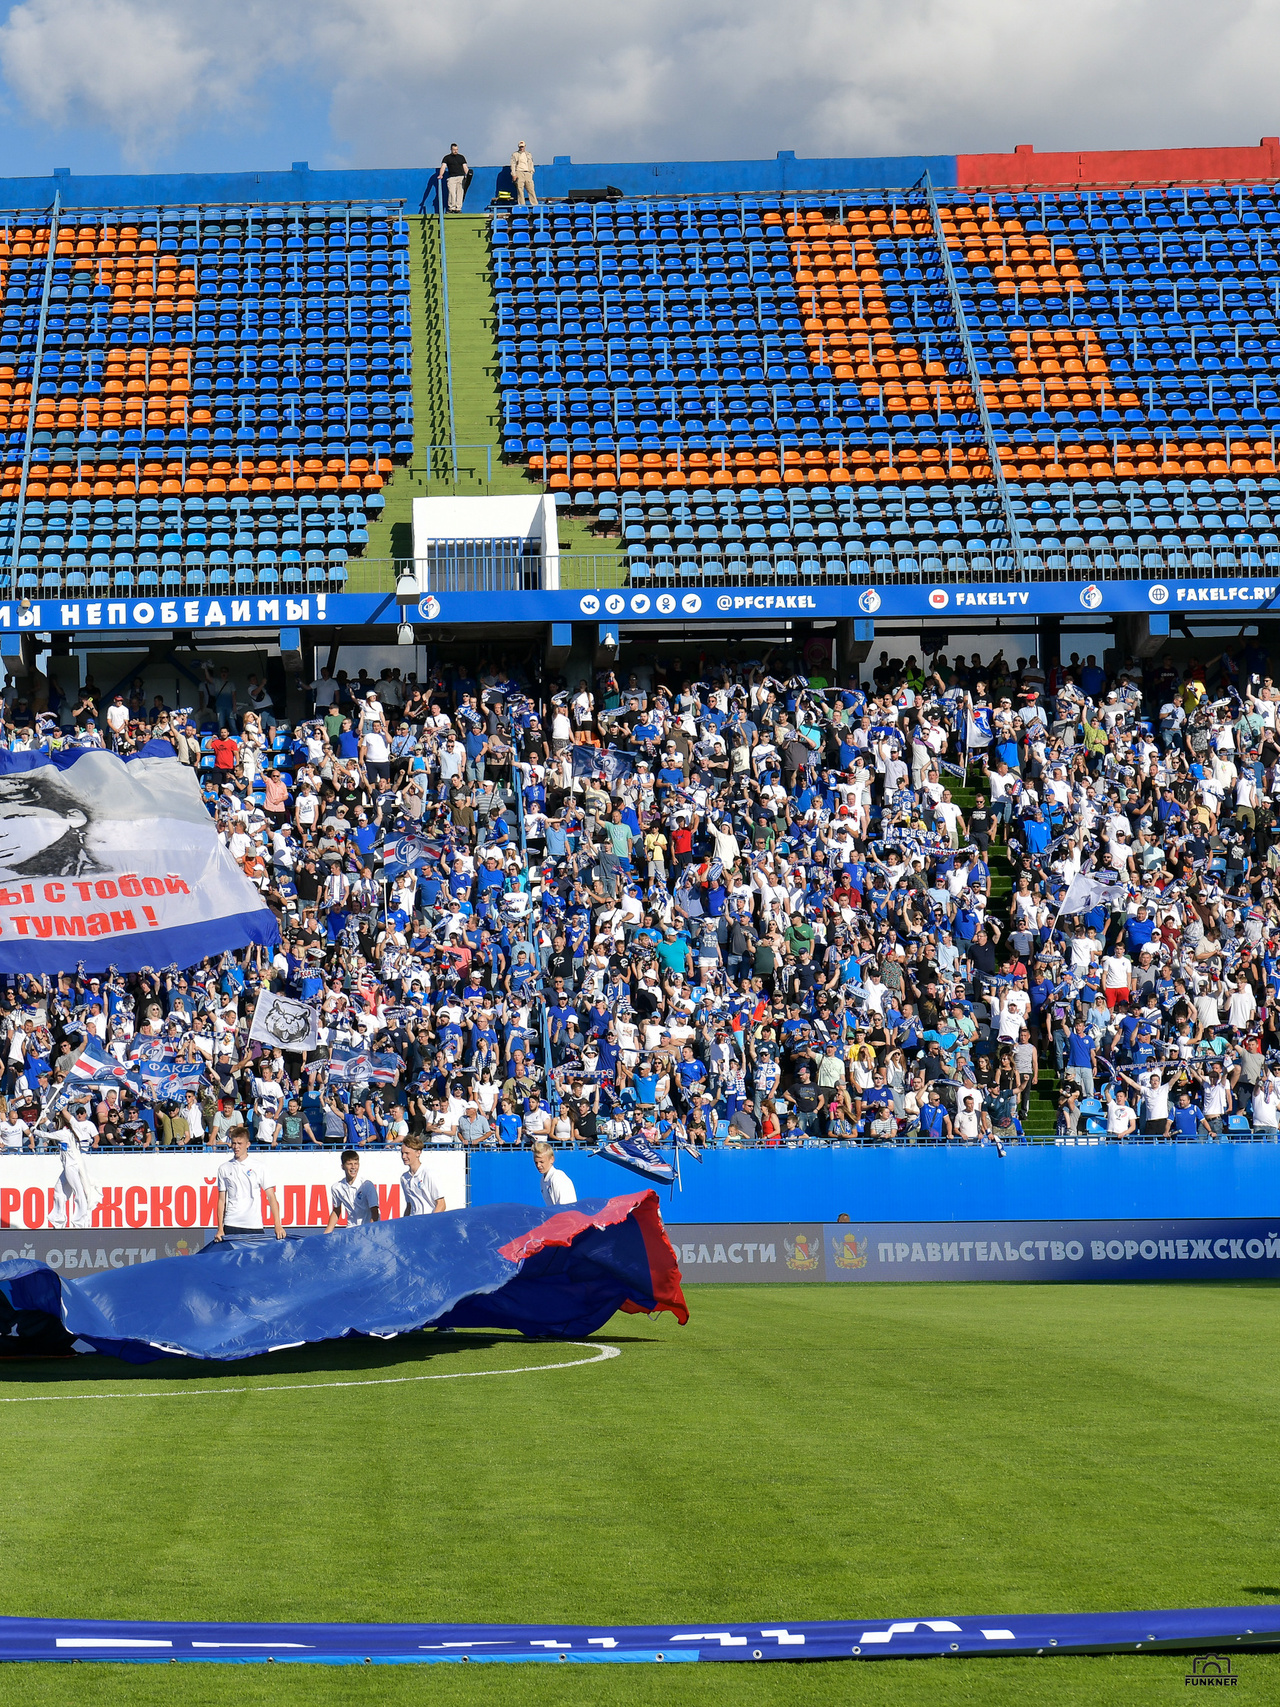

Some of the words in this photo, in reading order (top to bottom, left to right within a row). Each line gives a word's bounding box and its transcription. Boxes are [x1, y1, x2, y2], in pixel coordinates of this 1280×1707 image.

[955, 591, 1029, 606] FAKELTV
[1176, 586, 1276, 601] FAKELFC.RU
[60, 593, 327, 627] НЕПОБЕДИМЫ!
[716, 595, 816, 611] @PFCFAKEL
[877, 1240, 1084, 1262] ПРАВИТЕЛЬСТВО
[1091, 1232, 1280, 1261] ВОРОНЕЖСКОЙ
[45, 1248, 158, 1268] ОБЛАСТИ
